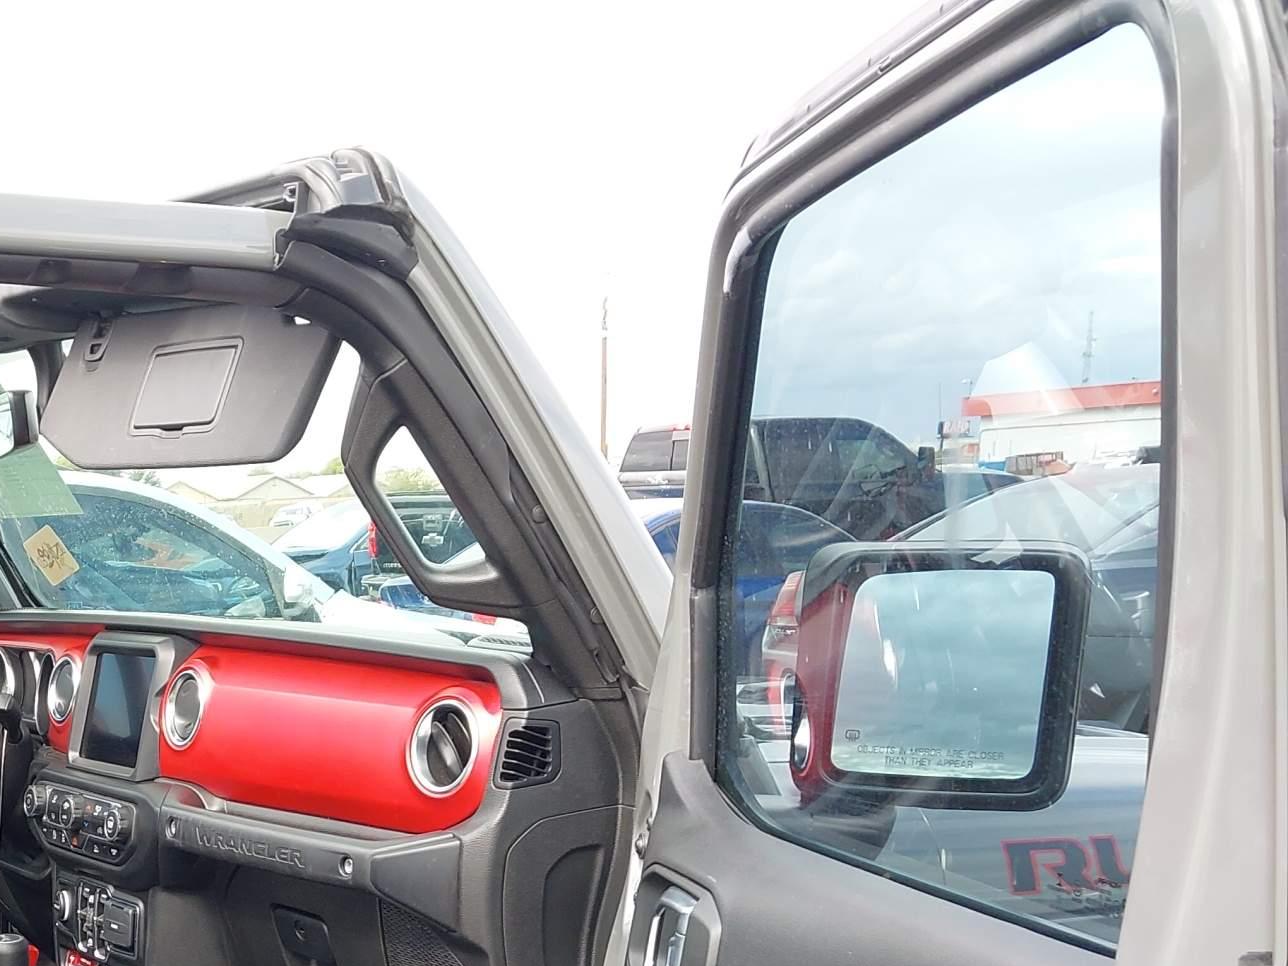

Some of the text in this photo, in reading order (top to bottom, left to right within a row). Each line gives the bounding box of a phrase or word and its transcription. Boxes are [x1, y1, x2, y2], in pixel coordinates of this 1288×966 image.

[856, 744, 896, 755] OBJECTS
[946, 748, 964, 760] ARE
[967, 749, 1005, 761] CLOSER
[884, 755, 974, 769] THAN THEY APPEAR
[195, 825, 306, 868] WRANGLER
